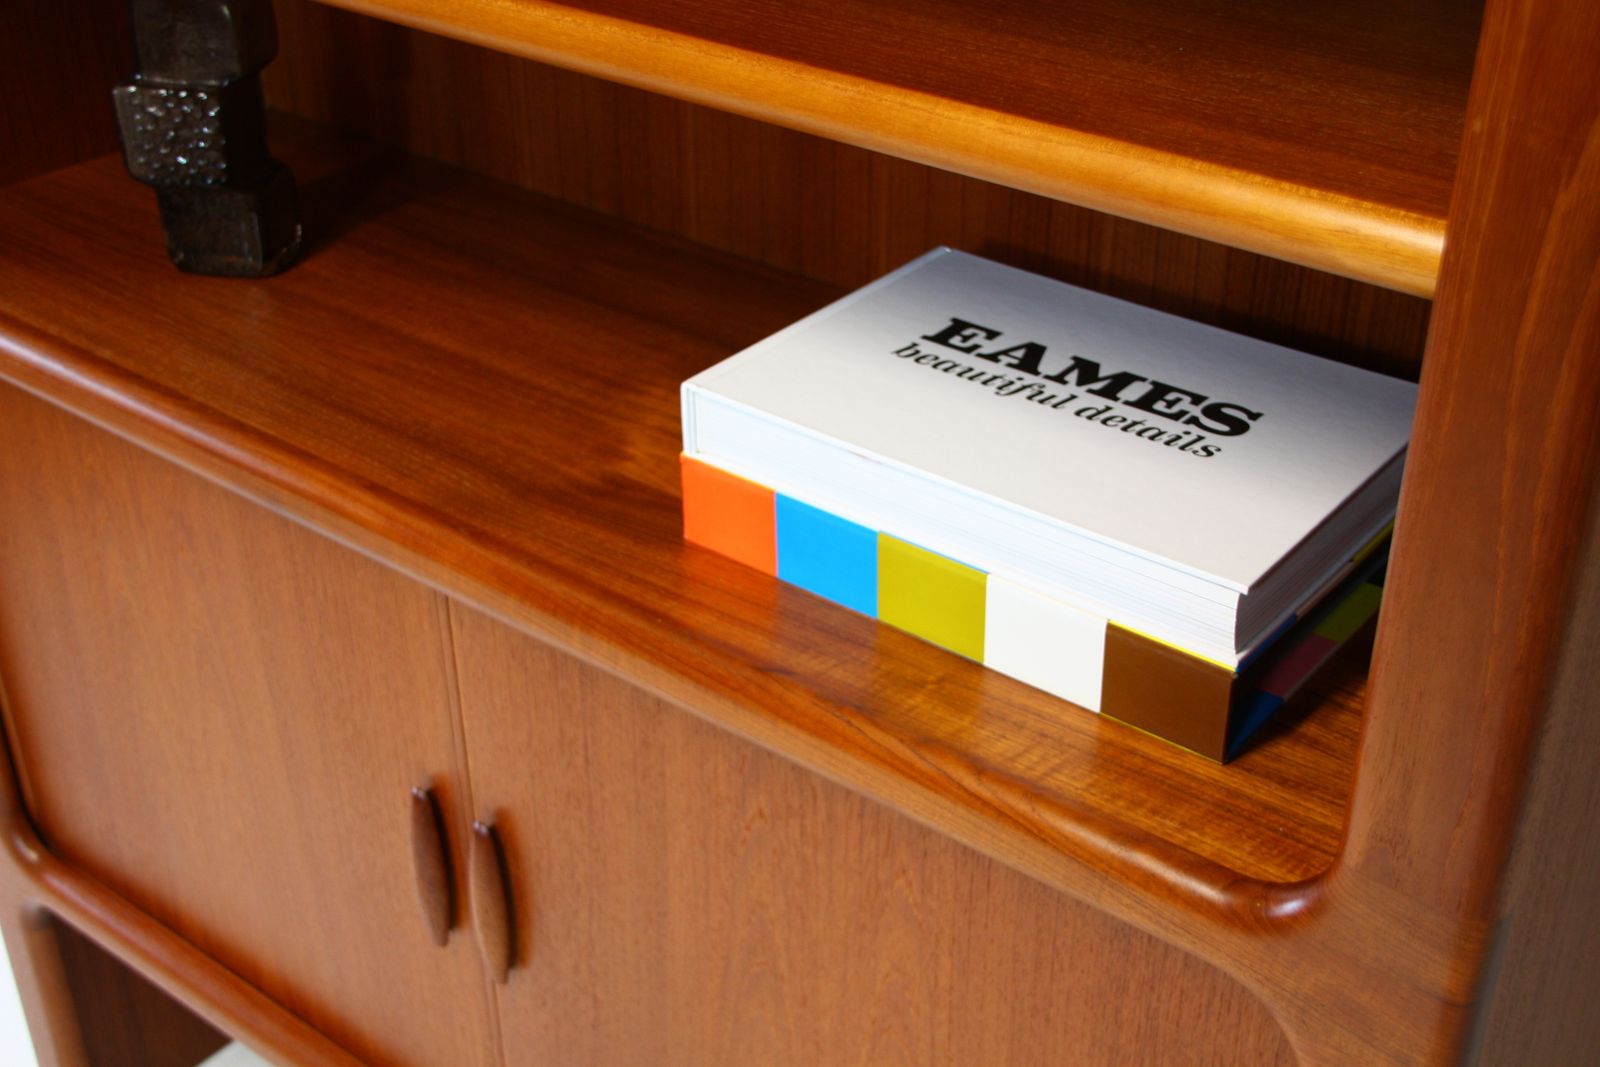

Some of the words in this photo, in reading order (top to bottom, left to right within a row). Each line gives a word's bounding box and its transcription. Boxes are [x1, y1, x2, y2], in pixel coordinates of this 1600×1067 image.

[891, 342, 1077, 409] beautiful
[1075, 400, 1222, 459] details
[920, 316, 1263, 438] EAMES
